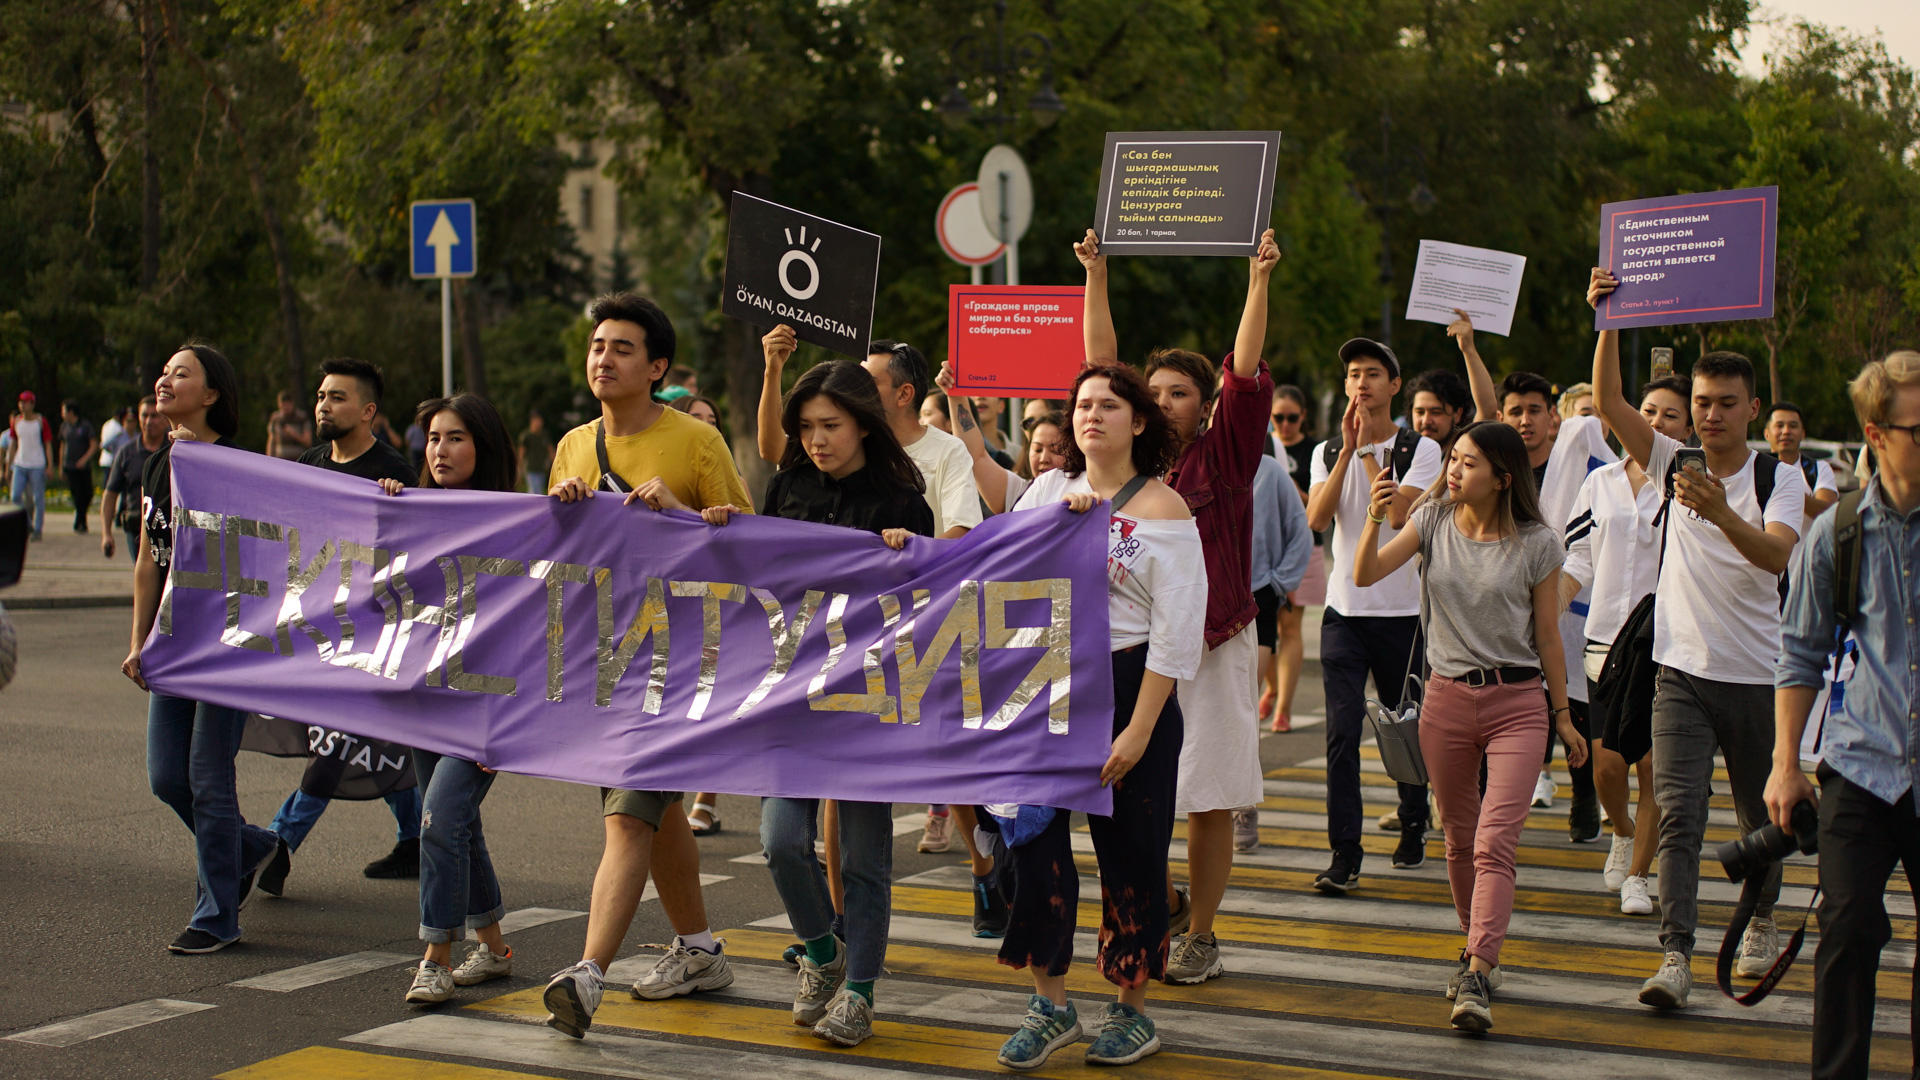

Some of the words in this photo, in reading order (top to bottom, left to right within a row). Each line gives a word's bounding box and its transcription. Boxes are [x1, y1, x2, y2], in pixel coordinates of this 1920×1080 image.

[1122, 150, 1149, 160] «Сөз
[1151, 149, 1173, 160] бен
[1125, 164, 1220, 175] шығармашылық
[1123, 175, 1188, 186] еркіндігіне
[1122, 187, 1170, 199] кепілдік
[1172, 187, 1226, 200] беріледі.
[1120, 200, 1183, 211] Цензураға
[1118, 212, 1156, 222] тыйым
[1158, 214, 1224, 223] салынады»
[1618, 213, 1710, 231] «Единственным
[1116, 228, 1127, 236] 20
[1623, 228, 1694, 243] источником
[1622, 237, 1726, 258] государственной
[1622, 258, 1662, 270] власти
[1664, 253, 1716, 266] является
[1621, 271, 1665, 284] народ»
[964, 300, 1021, 312] «Граждане
[1022, 303, 1060, 313] вправе
[968, 313, 1002, 323] мирно
[1013, 313, 1032, 323] без
[1033, 315, 1074, 325] оружия
[968, 324, 1032, 336] собираться»
